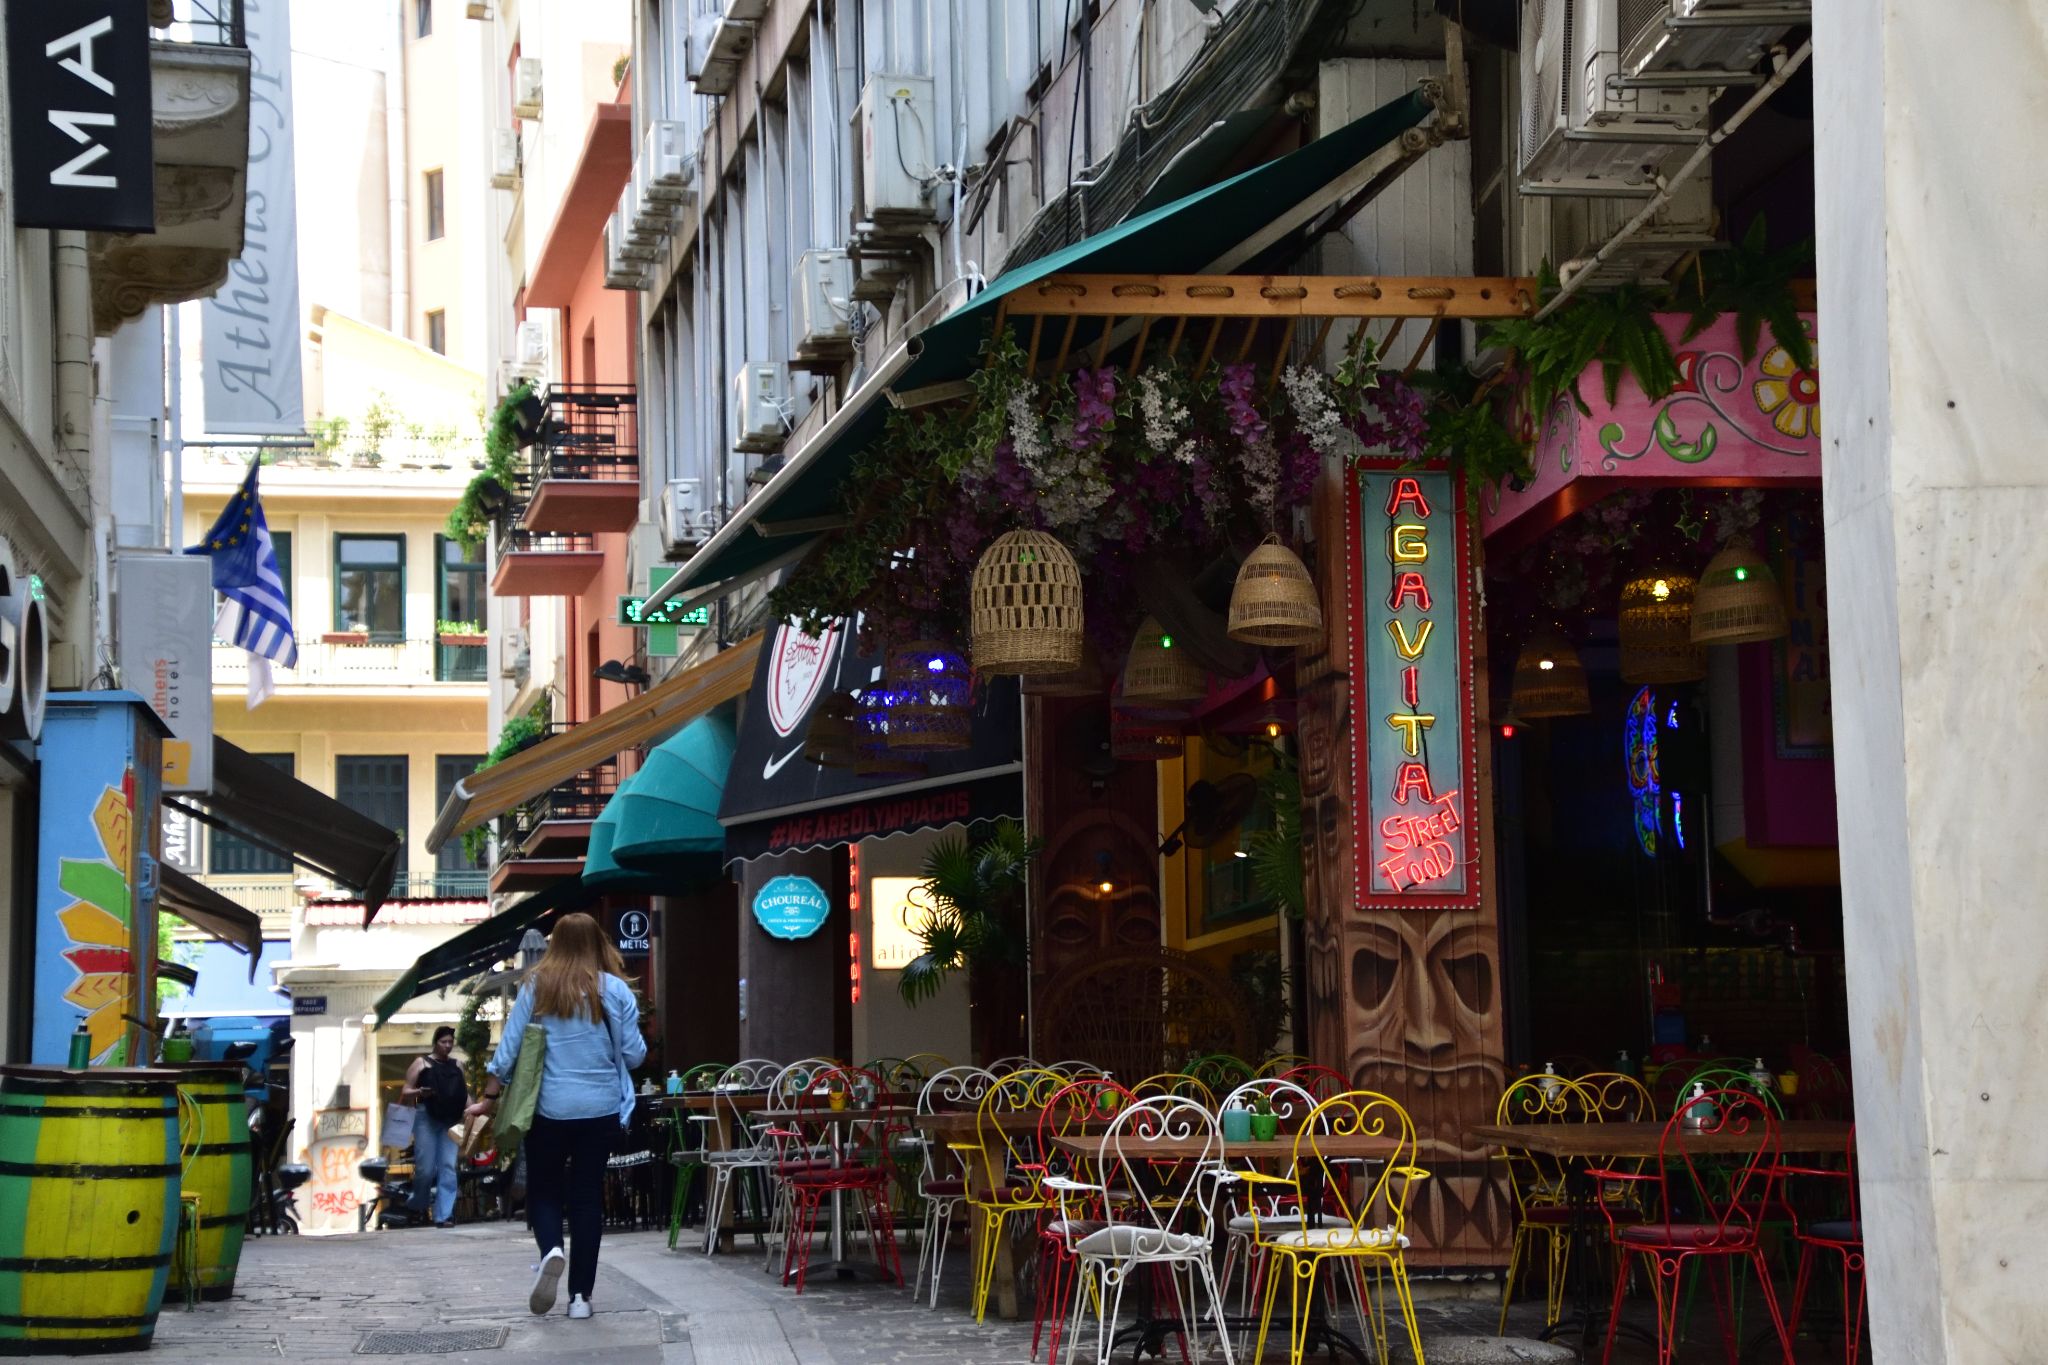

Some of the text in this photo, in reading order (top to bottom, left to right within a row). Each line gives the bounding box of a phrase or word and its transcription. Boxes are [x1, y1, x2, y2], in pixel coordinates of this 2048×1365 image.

[1384, 477, 1436, 805] AGAVITA
[168, 660, 179, 719] hotel
[768, 790, 971, 849] #WEAREOLYMPIACOS
[1380, 789, 1461, 852] STREET
[619, 939, 649, 949] METIS
